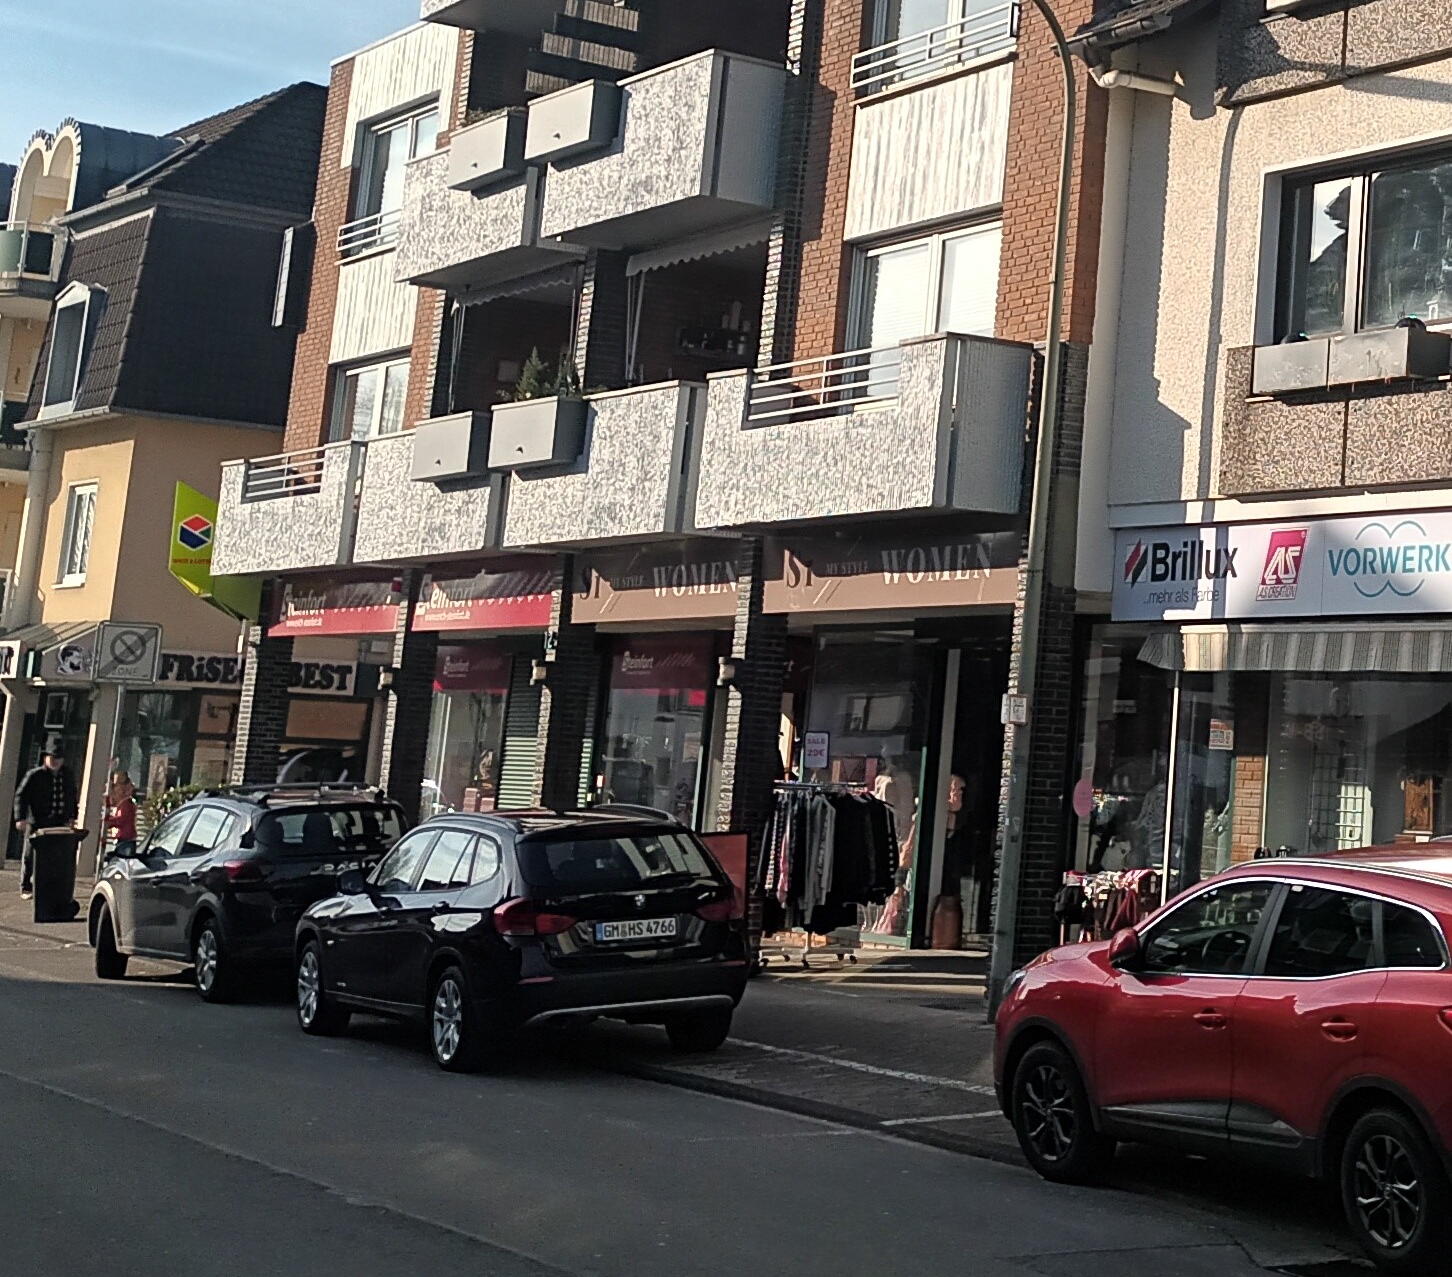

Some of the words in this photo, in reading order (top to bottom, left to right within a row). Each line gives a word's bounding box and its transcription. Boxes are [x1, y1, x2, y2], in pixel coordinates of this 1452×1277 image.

[881, 541, 993, 585] WOMEN
[1150, 539, 1238, 583] Brillux
[1327, 542, 1451, 577] VORWERK
[653, 560, 739, 598] WOMEN
[1175, 587, 1189, 603] als
[1191, 586, 1219, 603] Farbe
[285, 662, 353, 690] BEST
[324, 862, 378, 871] DACIA
[603, 924, 620, 938] GM
[628, 922, 644, 936] HS
[646, 919, 675, 935] 4766
